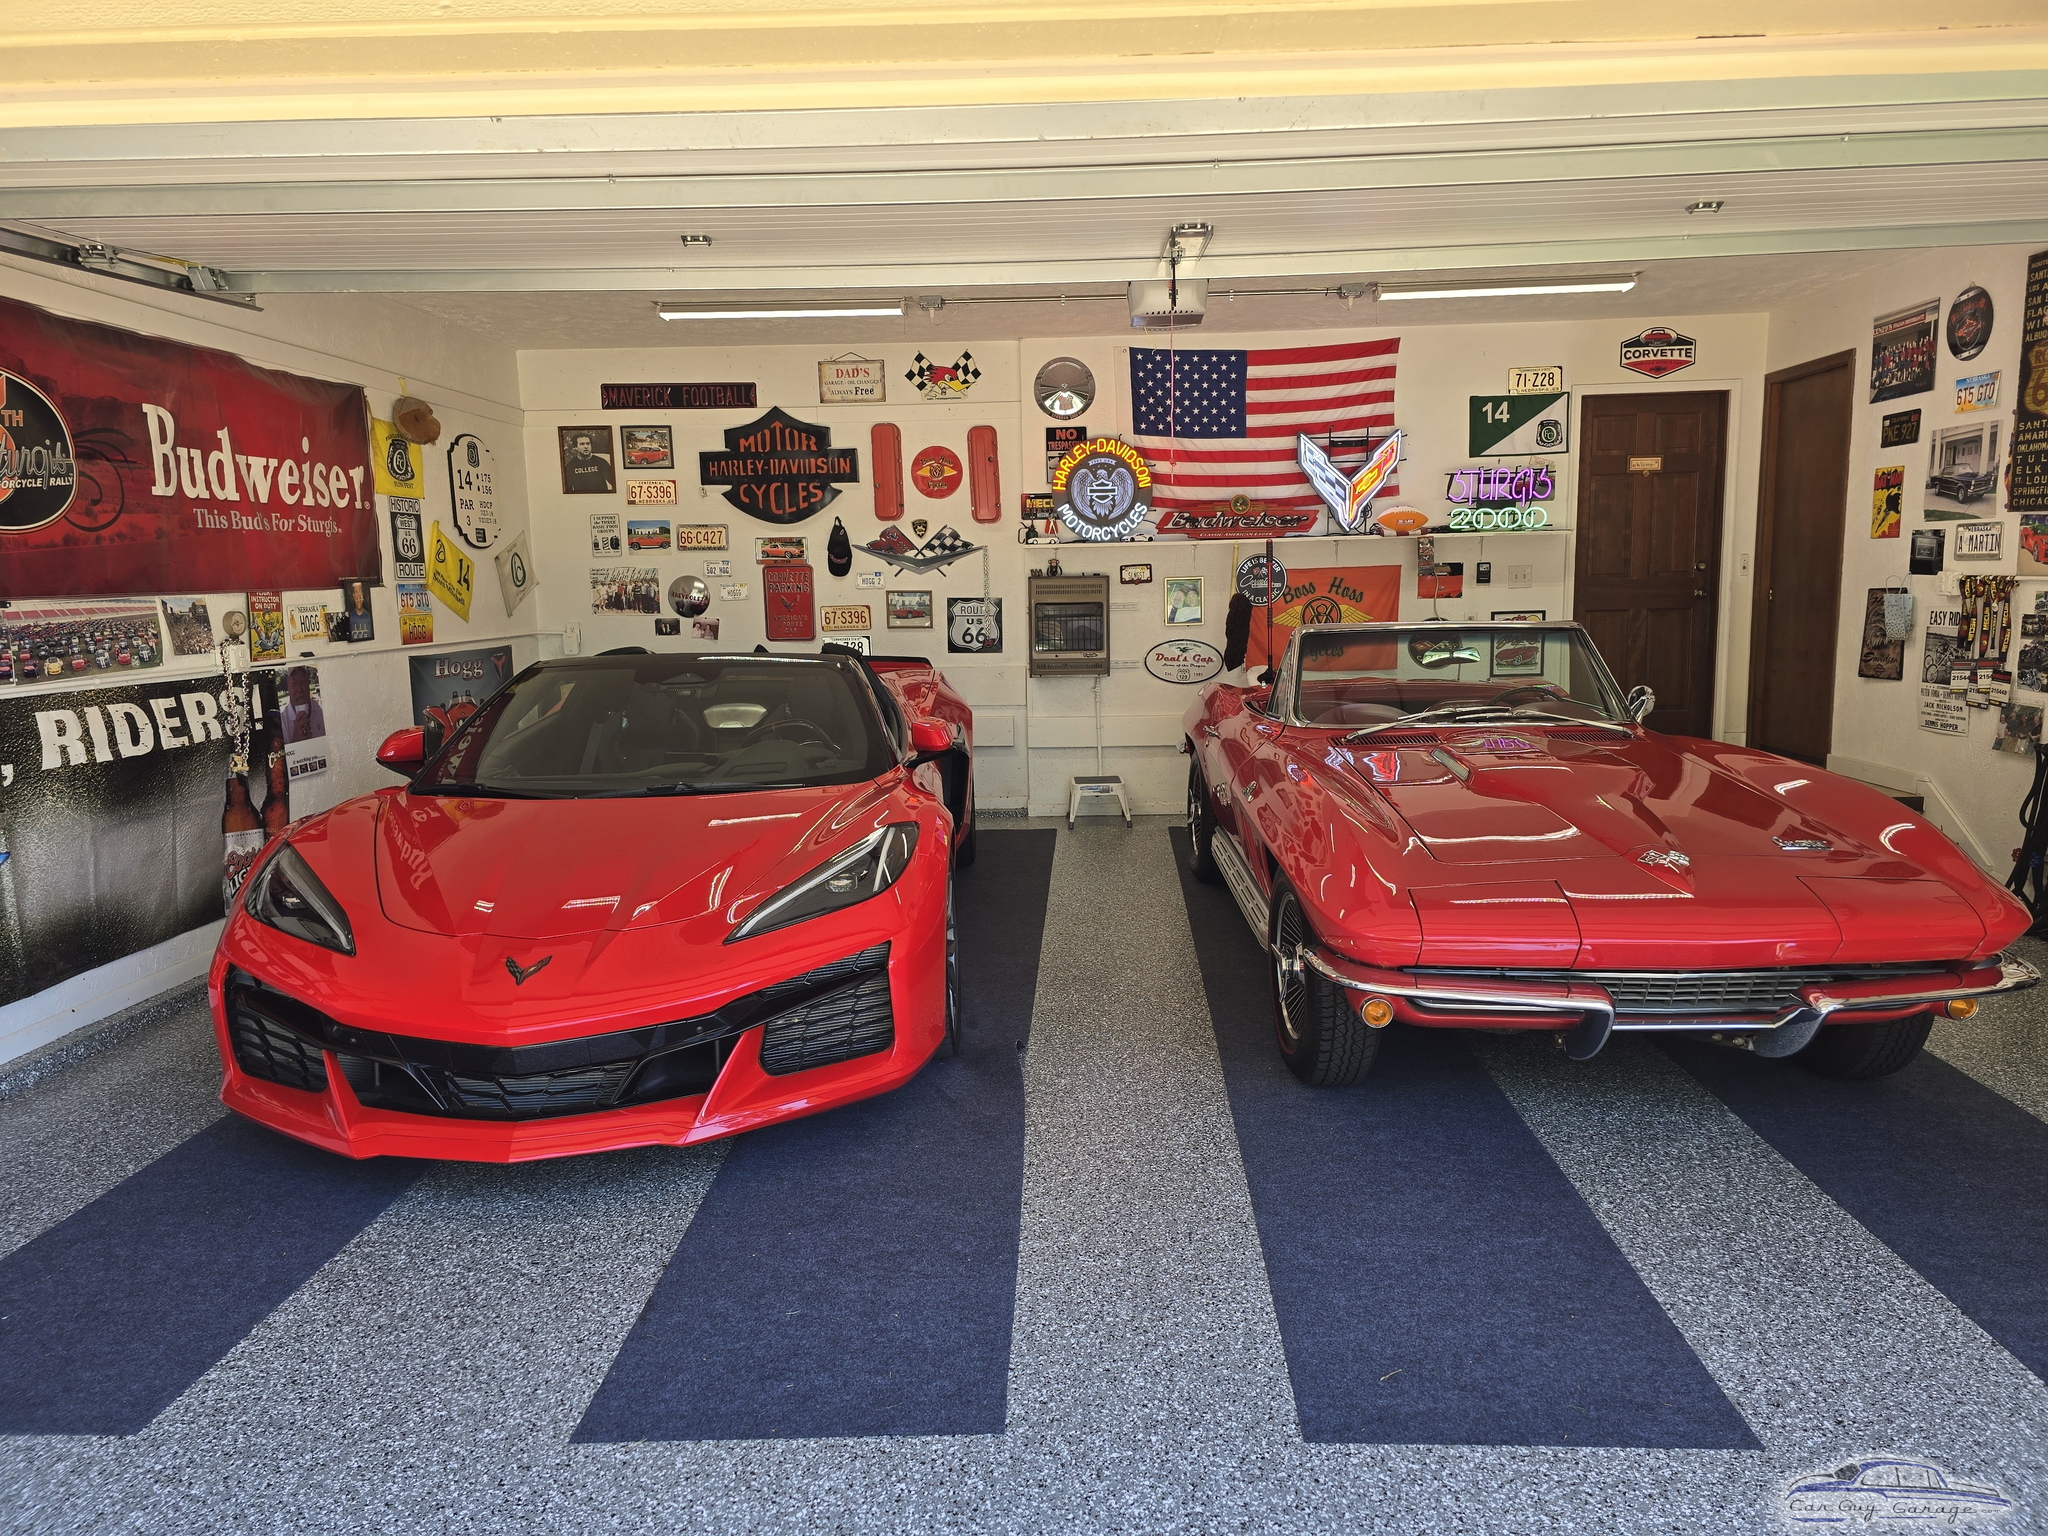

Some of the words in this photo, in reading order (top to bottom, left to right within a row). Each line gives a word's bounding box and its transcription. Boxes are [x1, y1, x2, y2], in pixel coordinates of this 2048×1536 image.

[1623, 347, 1693, 360] CORVETTE
[836, 367, 870, 378] DAD'S
[1966, 374, 1990, 384] NEBRASKA
[607, 387, 673, 407] MAVERICK
[682, 386, 751, 406] FOOTBALL
[854, 386, 874, 396] Free
[1482, 401, 1510, 424] 14
[739, 421, 818, 453] MOTOR
[1055, 429, 1078, 440] NO
[1883, 424, 1900, 442] PKE
[1901, 421, 1917, 440] 927
[142, 403, 366, 510] Budweiser
[1052, 438, 1152, 490] HARLEY-DAVIDSON
[574, 466, 599, 474] COLLEGE
[709, 457, 851, 477] HARLEY-DAVIDSON
[49, 476, 74, 487] RALLY
[457, 469, 473, 491] 14
[480, 473, 491, 483] 175
[1448, 468, 1552, 508] STURGIS
[481, 485, 493, 495] 156
[739, 482, 824, 514] CYCLES
[390, 498, 420, 514] HISTORIC
[459, 498, 475, 511] PAR
[193, 507, 229, 530] This
[229, 509, 270, 532] Bud's
[271, 512, 296, 532] For
[400, 519, 413, 528] WEST
[466, 515, 472, 527] 3
[1056, 502, 1148, 541] MOTORCYCLES
[1163, 510, 1310, 529] Budweiser
[1449, 506, 1548, 529] 2000
[401, 537, 417, 554] 66
[1957, 535, 1963, 553] A
[1967, 533, 2001, 552] MARTIN
[398, 562, 425, 577] ROUTE
[1240, 561, 1253, 574] LIFE
[1259, 557, 1281, 573] BETER
[457, 558, 471, 592] 14
[768, 571, 810, 582] CORVETTE
[768, 583, 810, 594] PARKING
[1282, 581, 1316, 604] Boss
[1327, 576, 1364, 604] Hoss
[251, 595, 280, 603] INSTRUCTOR
[298, 604, 319, 613] NEBRASKA
[960, 605, 984, 615] ROUT
[299, 614, 320, 633] HOGG
[1929, 610, 1948, 626] EASY
[961, 627, 988, 645] 66
[1192, 653, 1214, 664] Gap
[434, 658, 484, 680] Hogg
[1936, 702, 1964, 713] NICHOLSON
